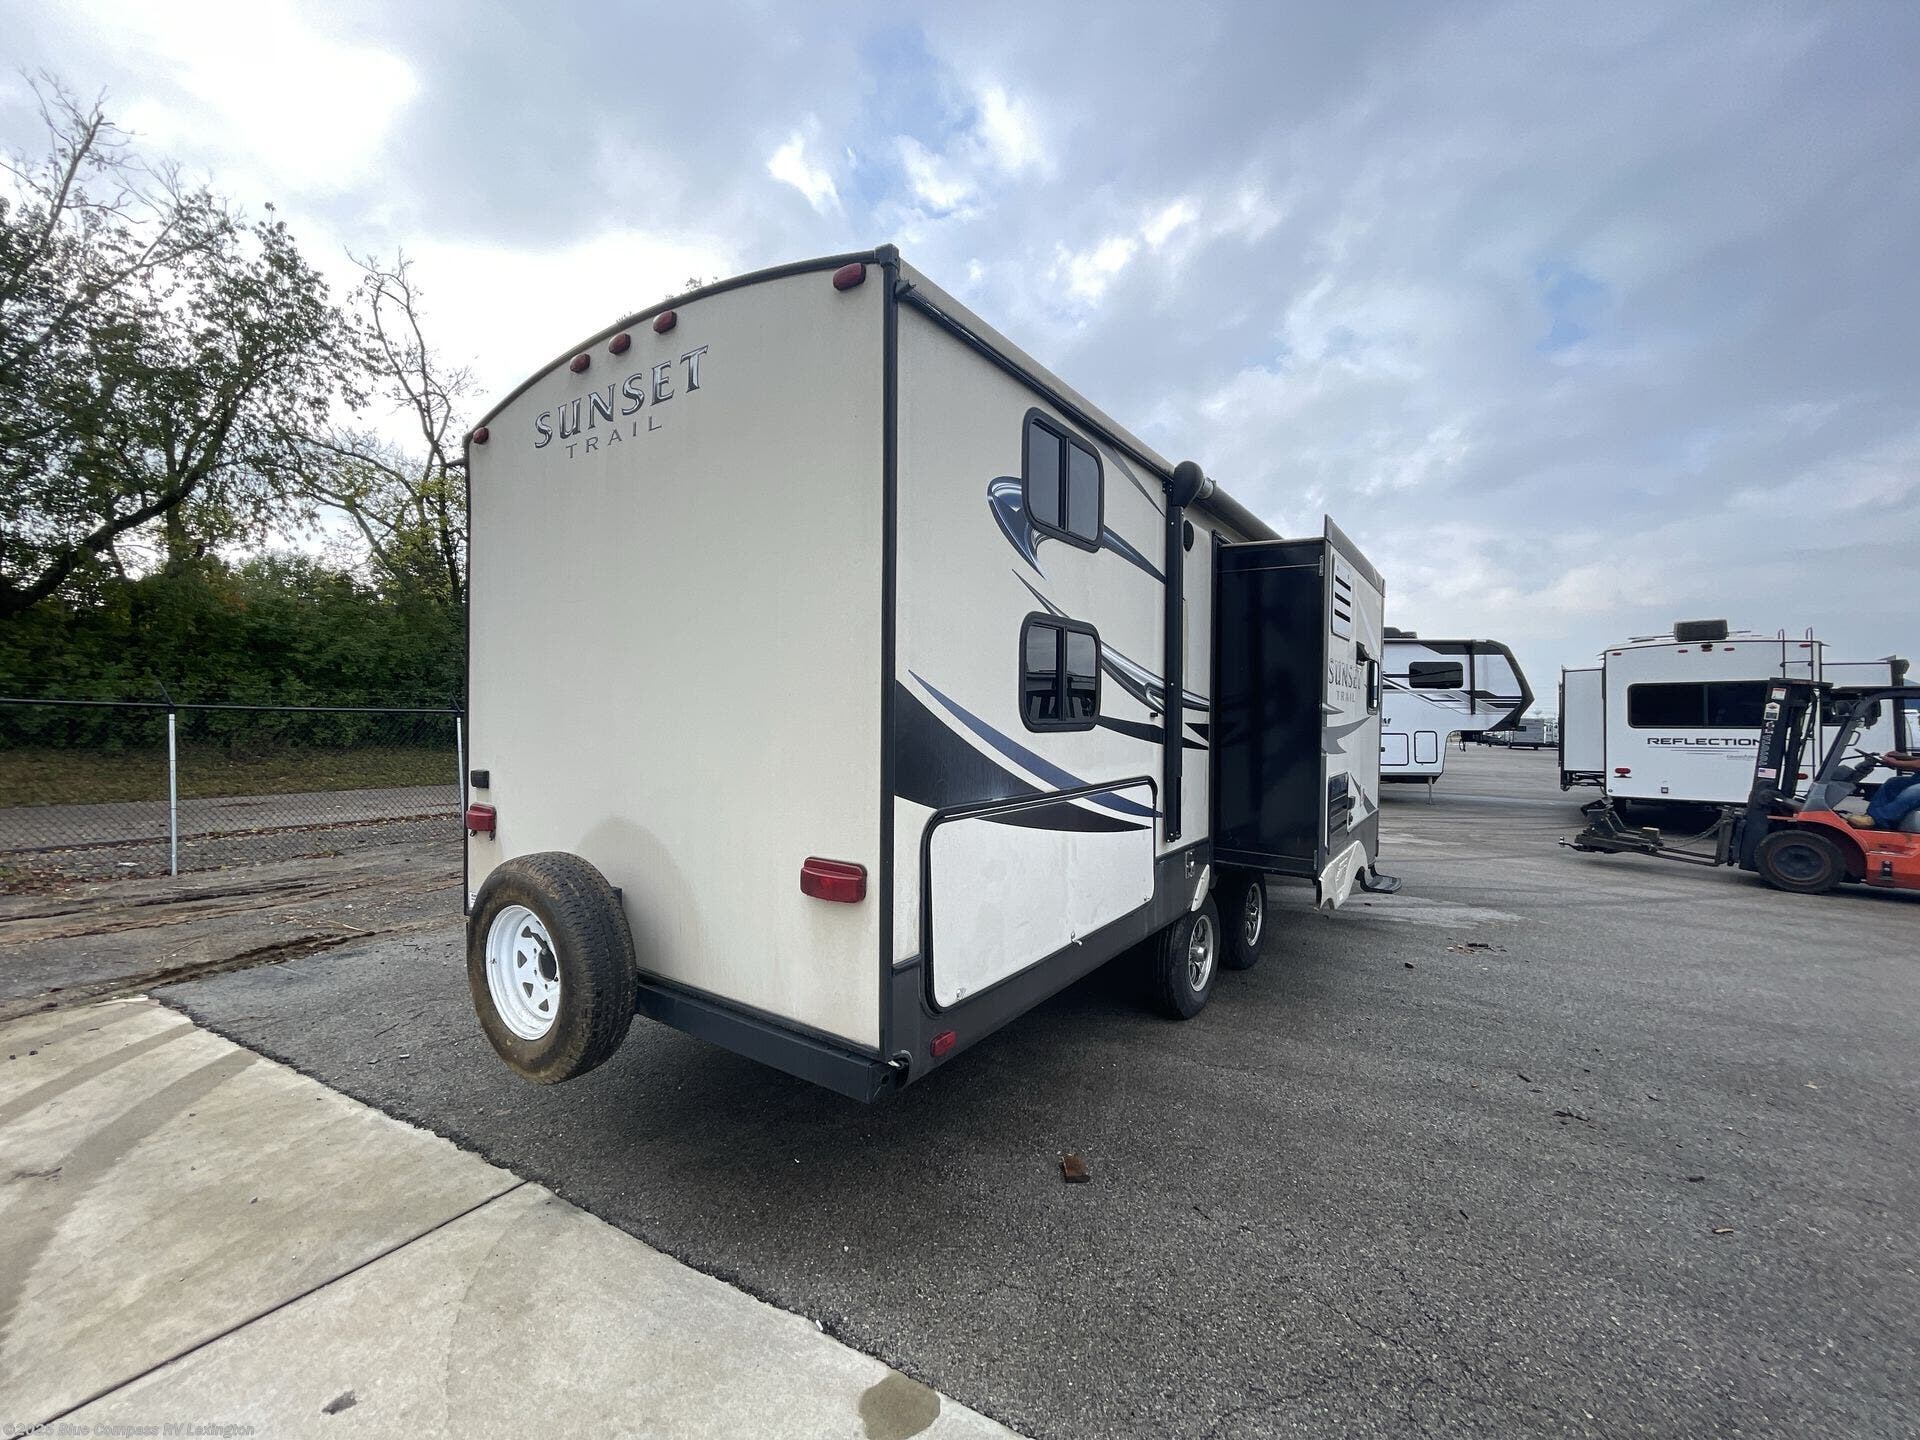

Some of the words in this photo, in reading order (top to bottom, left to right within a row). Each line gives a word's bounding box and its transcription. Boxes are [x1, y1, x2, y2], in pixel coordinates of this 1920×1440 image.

[534, 344, 709, 449] SUNSET
[566, 415, 663, 458] TRAIL
[1329, 658, 1361, 689] SUNSET
[1336, 691, 1356, 702] TRAIL
[1758, 734, 1773, 767] TOYOTA
